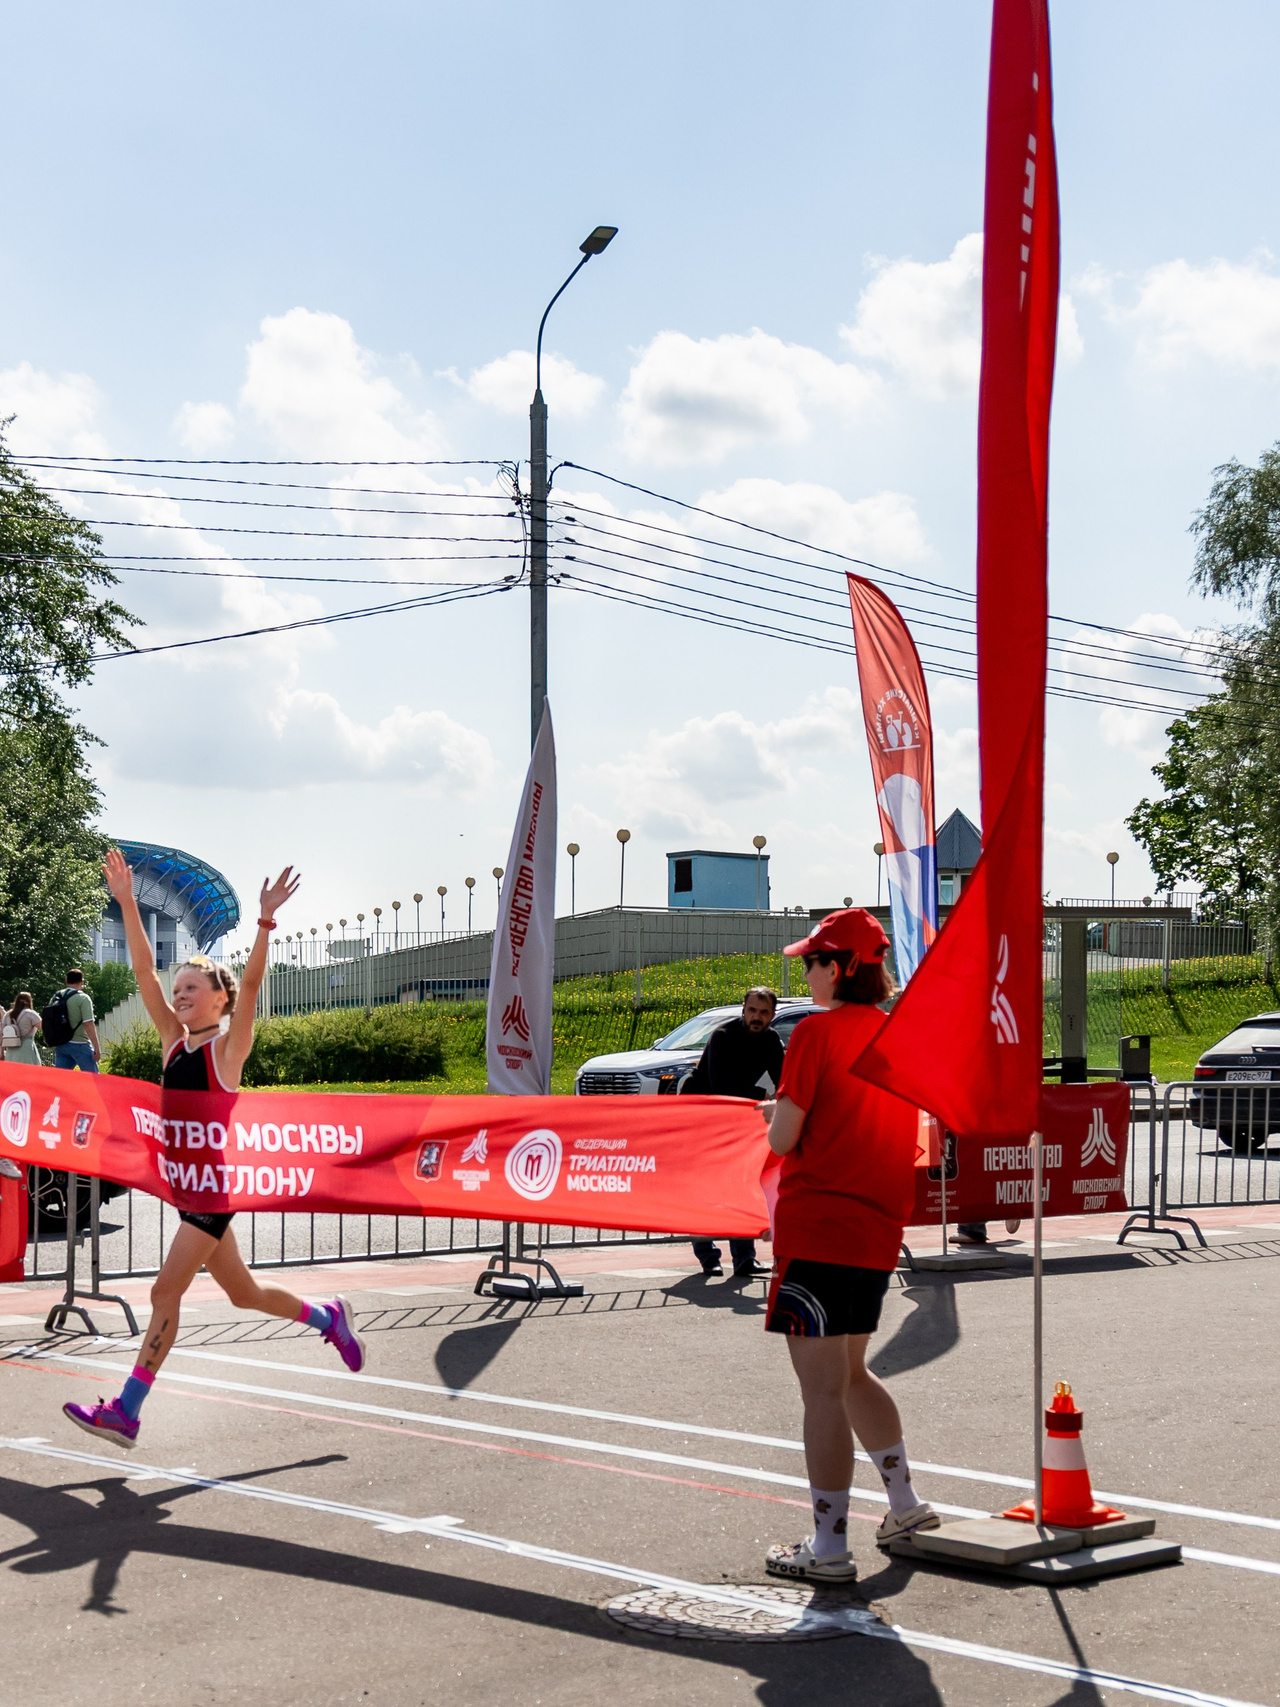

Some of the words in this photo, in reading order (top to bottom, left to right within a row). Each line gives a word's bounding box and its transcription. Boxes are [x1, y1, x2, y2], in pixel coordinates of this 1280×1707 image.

[235, 1122, 363, 1155] МОСКВЫ
[573, 1138, 628, 1150] ФЕДЕРАЦИЯ
[569, 1155, 656, 1173] ТРИАТЛОНА
[567, 1174, 631, 1192] МОСКВЫ
[1072, 1174, 1121, 1194] МОСКОВСКИЙ
[1083, 1195, 1108, 1210] СПОРТ
[767, 1560, 806, 1576] crocs
